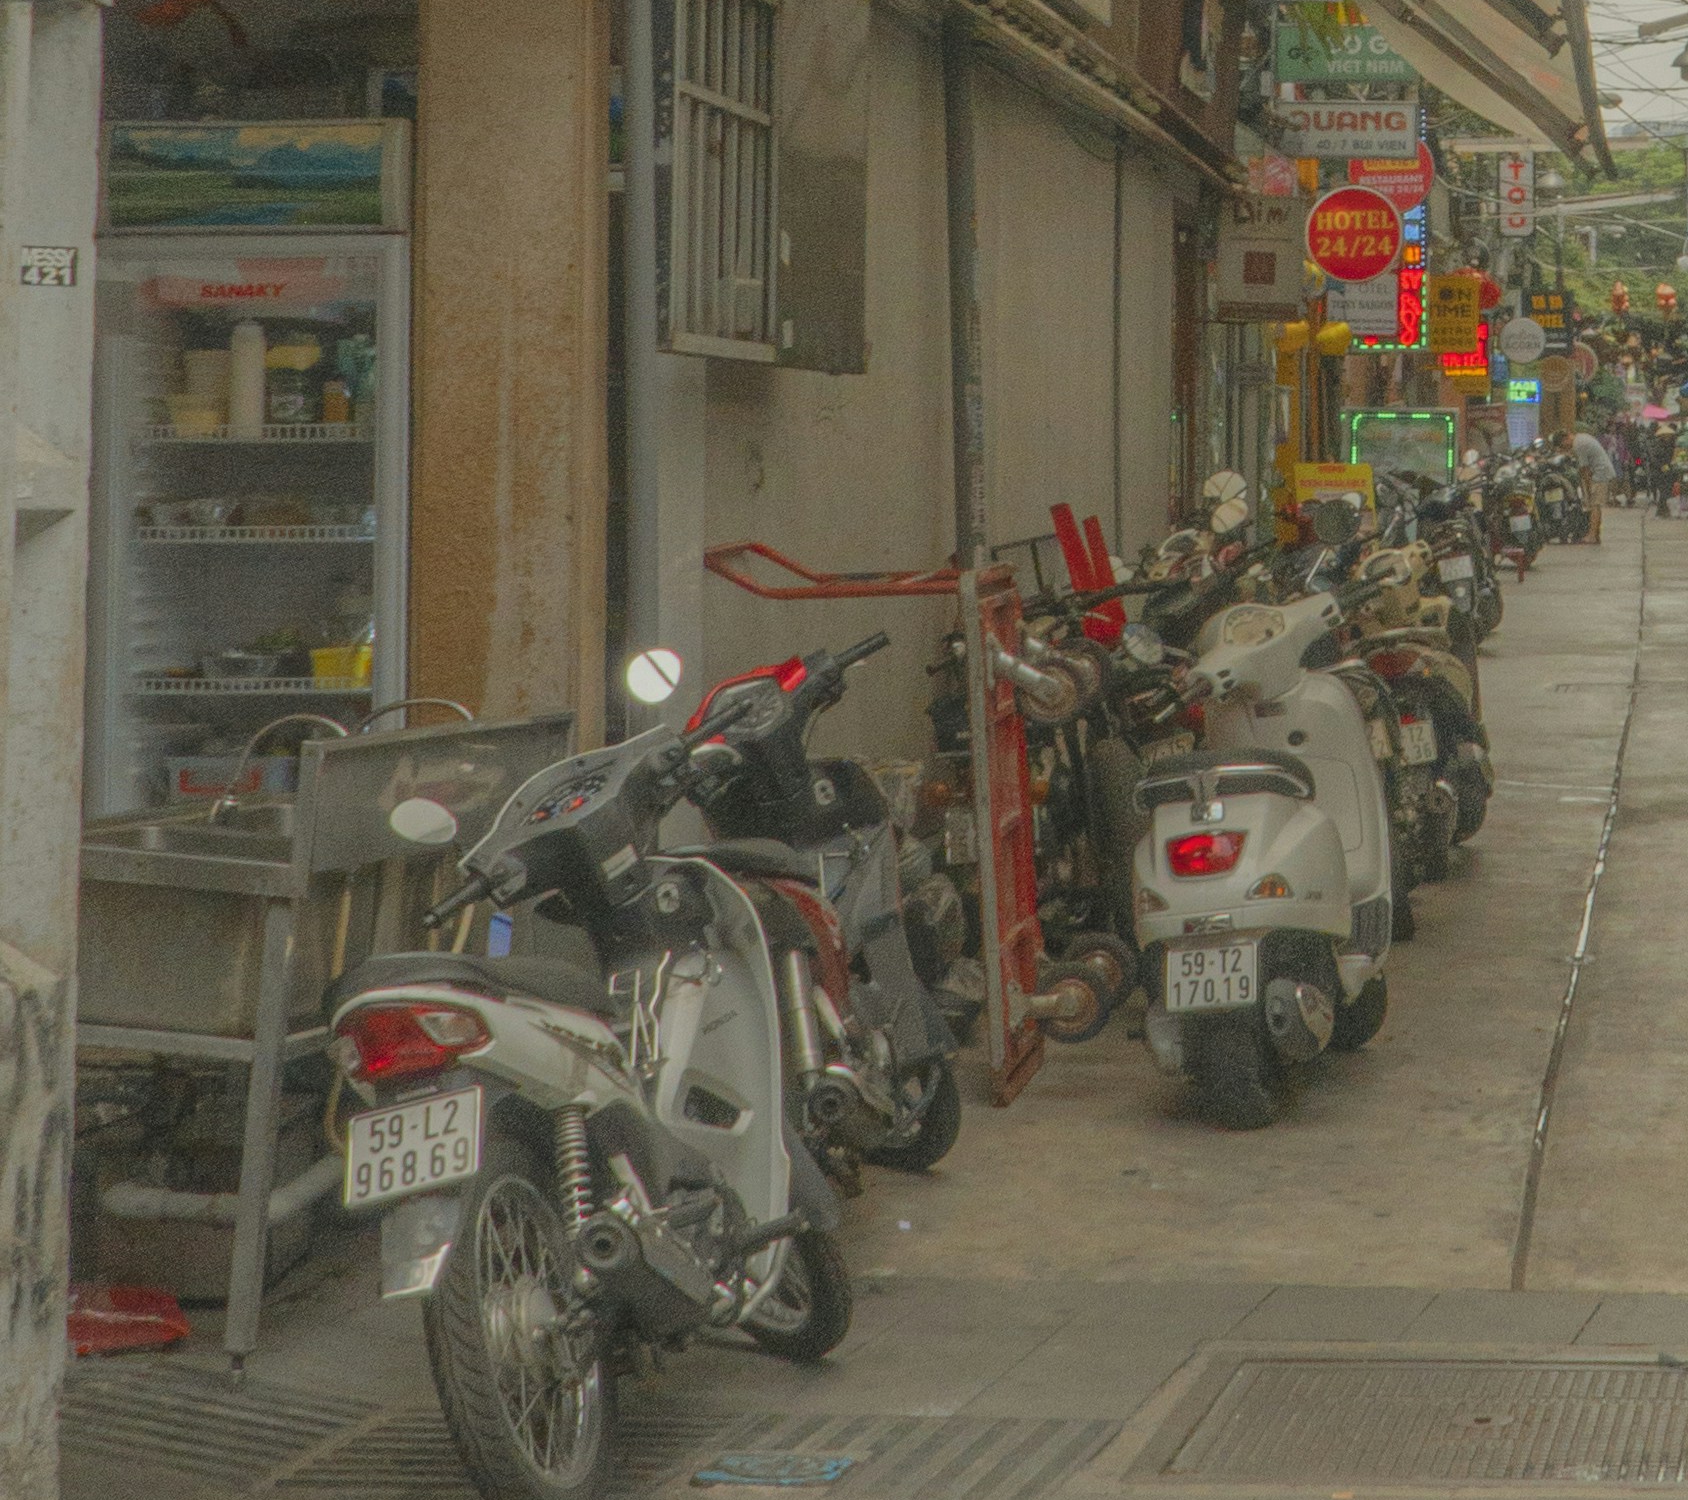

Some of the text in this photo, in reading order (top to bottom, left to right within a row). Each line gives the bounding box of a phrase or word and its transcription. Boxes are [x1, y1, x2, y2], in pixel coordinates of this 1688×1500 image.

[1316, 210, 1394, 231] HOTEL
[1316, 236, 1393, 259] 24/24
[23, 266, 71, 285] 421
[200, 282, 286, 299] SANAKY
[1181, 948, 1243, 977] 59-T2
[1173, 975, 1250, 1007] 170.19
[369, 1099, 460, 1154] 59-L2
[355, 1136, 469, 1198] 968.69
